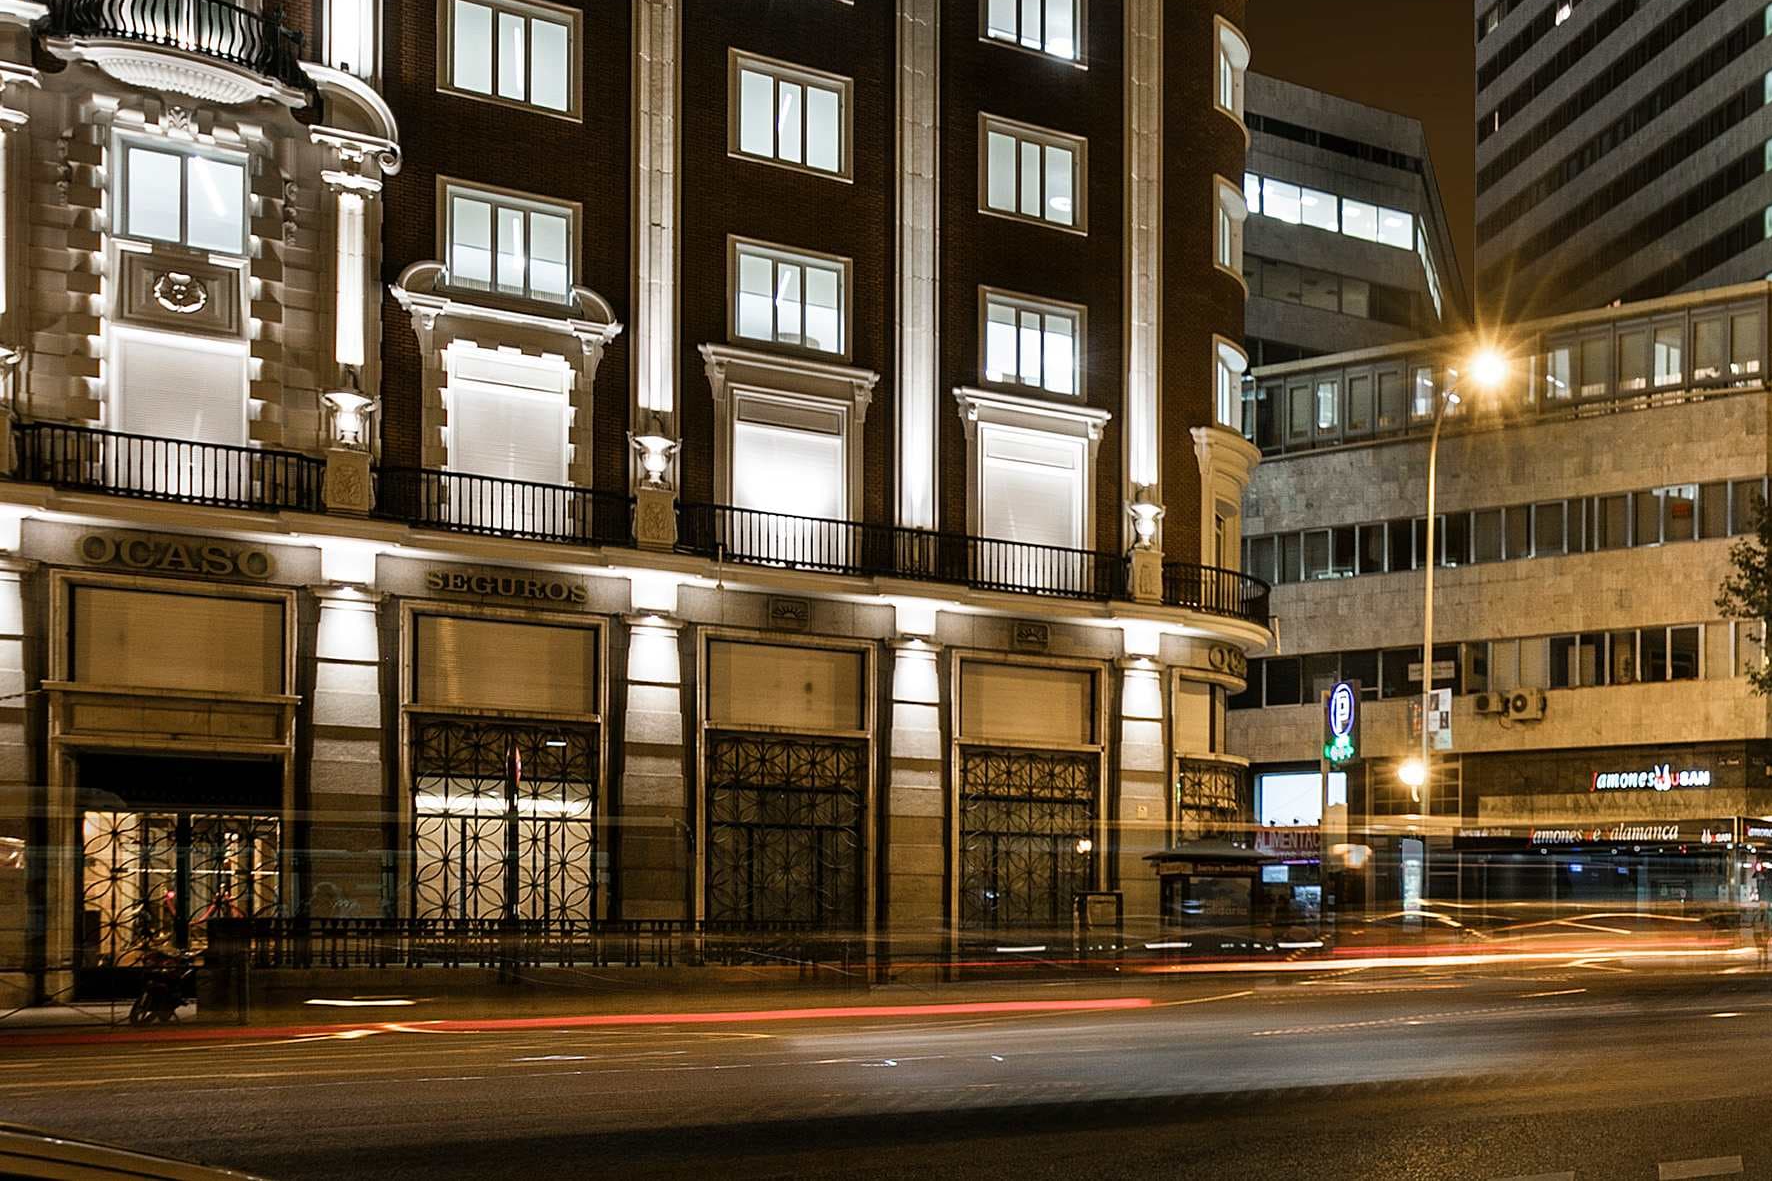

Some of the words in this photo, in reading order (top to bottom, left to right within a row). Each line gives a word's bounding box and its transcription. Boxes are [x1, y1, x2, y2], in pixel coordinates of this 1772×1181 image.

[75, 530, 276, 581] OCASO
[425, 569, 589, 606] SEGUROS
[1588, 770, 1656, 792] Jamones
[1526, 825, 1583, 847] Jamones
[1585, 825, 1601, 842] de
[1605, 823, 1679, 841] Salamanca
